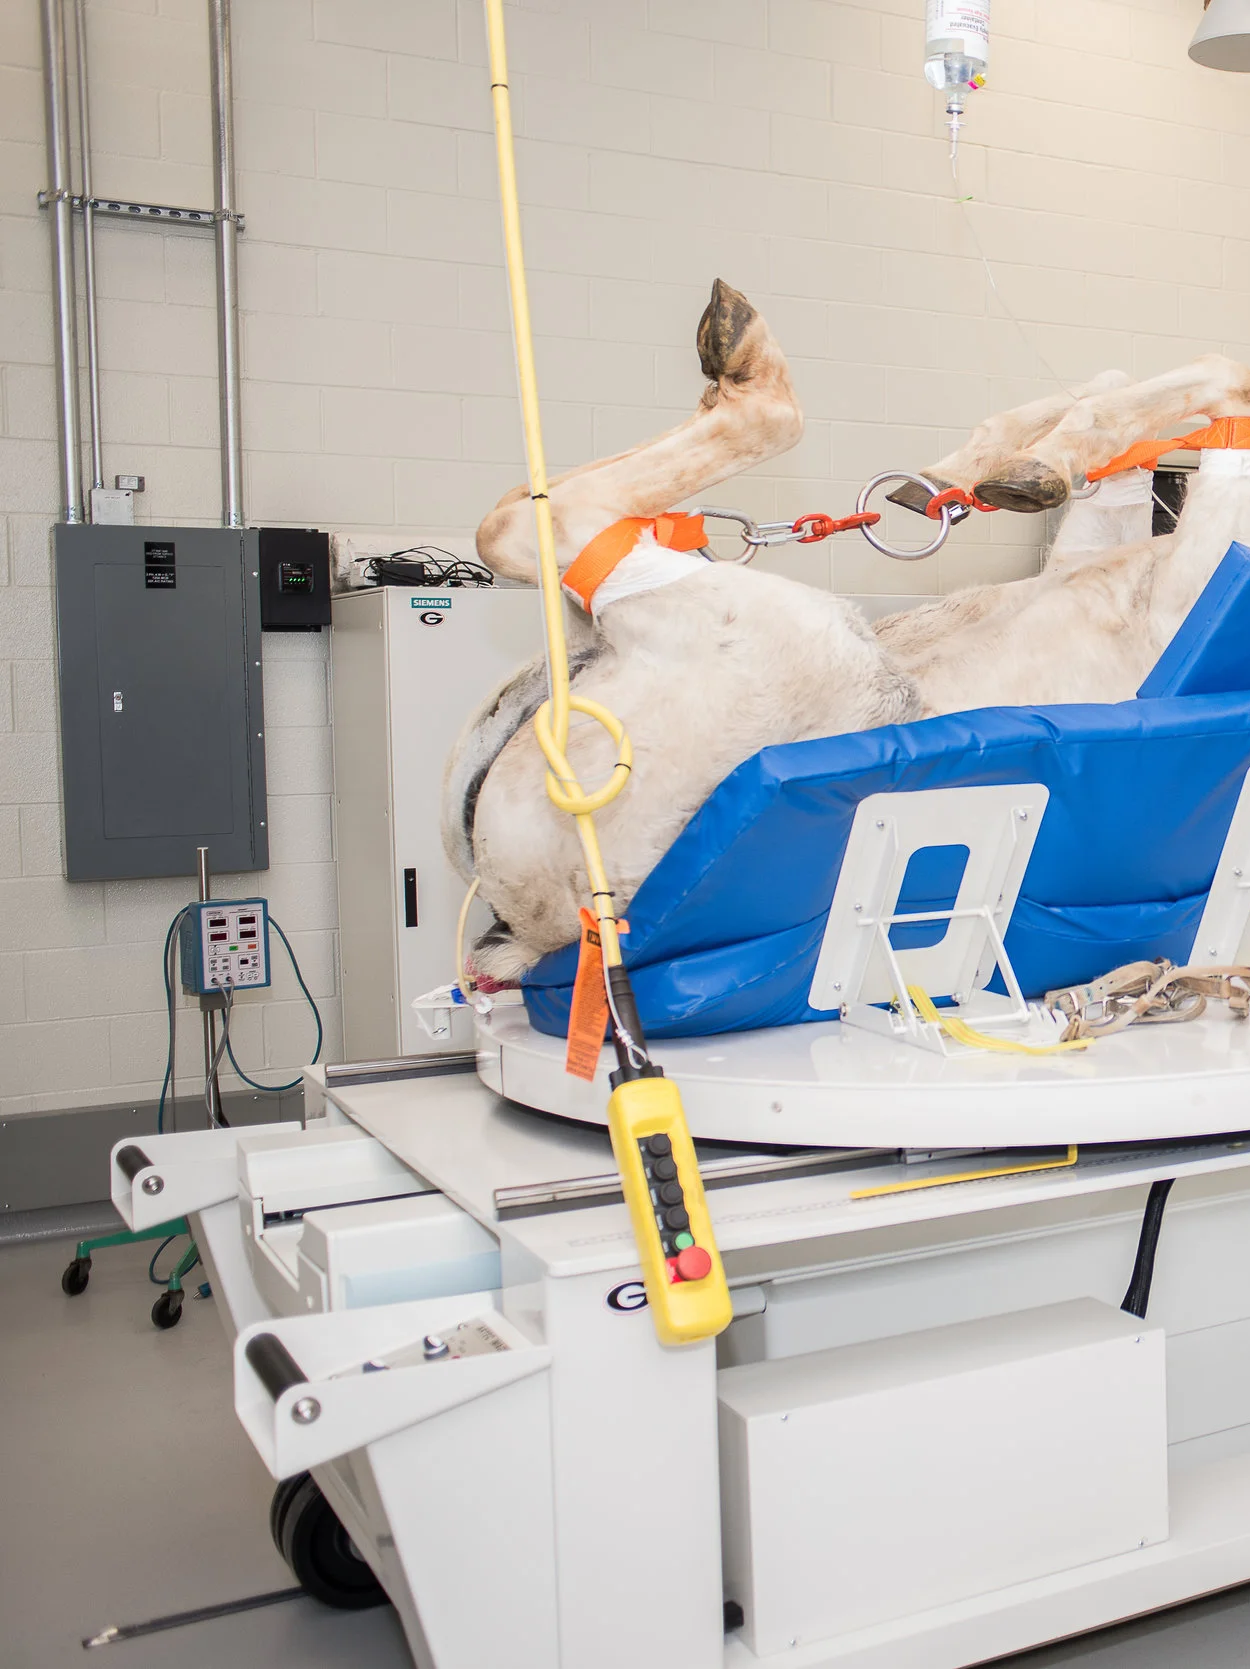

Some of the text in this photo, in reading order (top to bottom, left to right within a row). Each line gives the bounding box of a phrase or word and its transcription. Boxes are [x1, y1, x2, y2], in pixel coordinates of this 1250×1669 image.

[413, 599, 450, 607] SIEMENS
[420, 611, 444, 626] G
[607, 1281, 650, 1311] G
